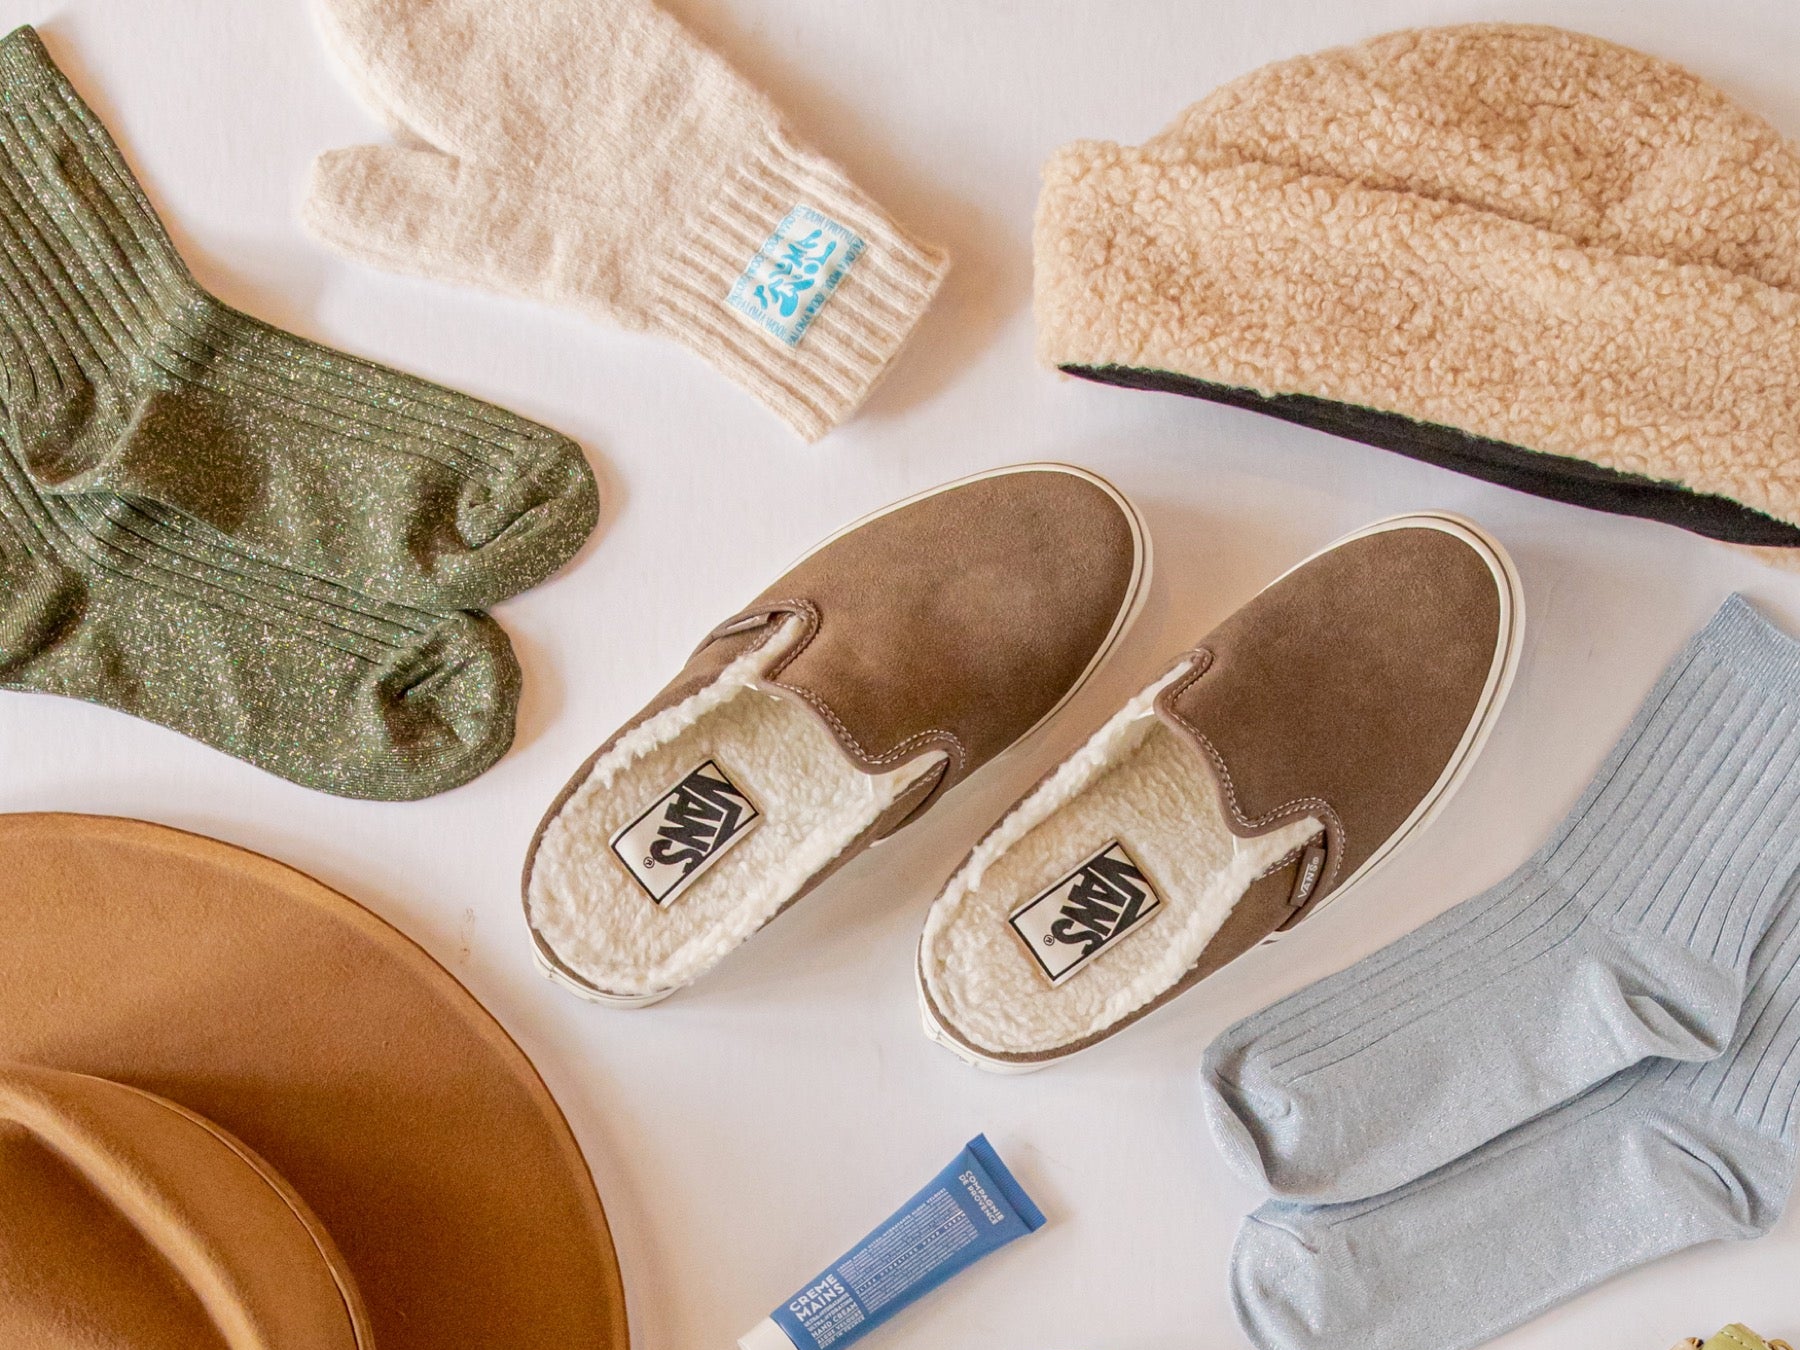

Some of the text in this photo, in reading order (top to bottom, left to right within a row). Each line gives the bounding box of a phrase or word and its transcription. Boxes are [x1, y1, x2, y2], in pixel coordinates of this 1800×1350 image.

[650, 771, 743, 873] VANS
[1051, 853, 1147, 954] VANS
[958, 1174, 1001, 1225] DE PROVENCE
[965, 1170, 1005, 1221] COMPAGNIE
[788, 1273, 837, 1312] CREME
[795, 1281, 845, 1321] MAINS
[811, 1302, 857, 1337] HAND CREAM
